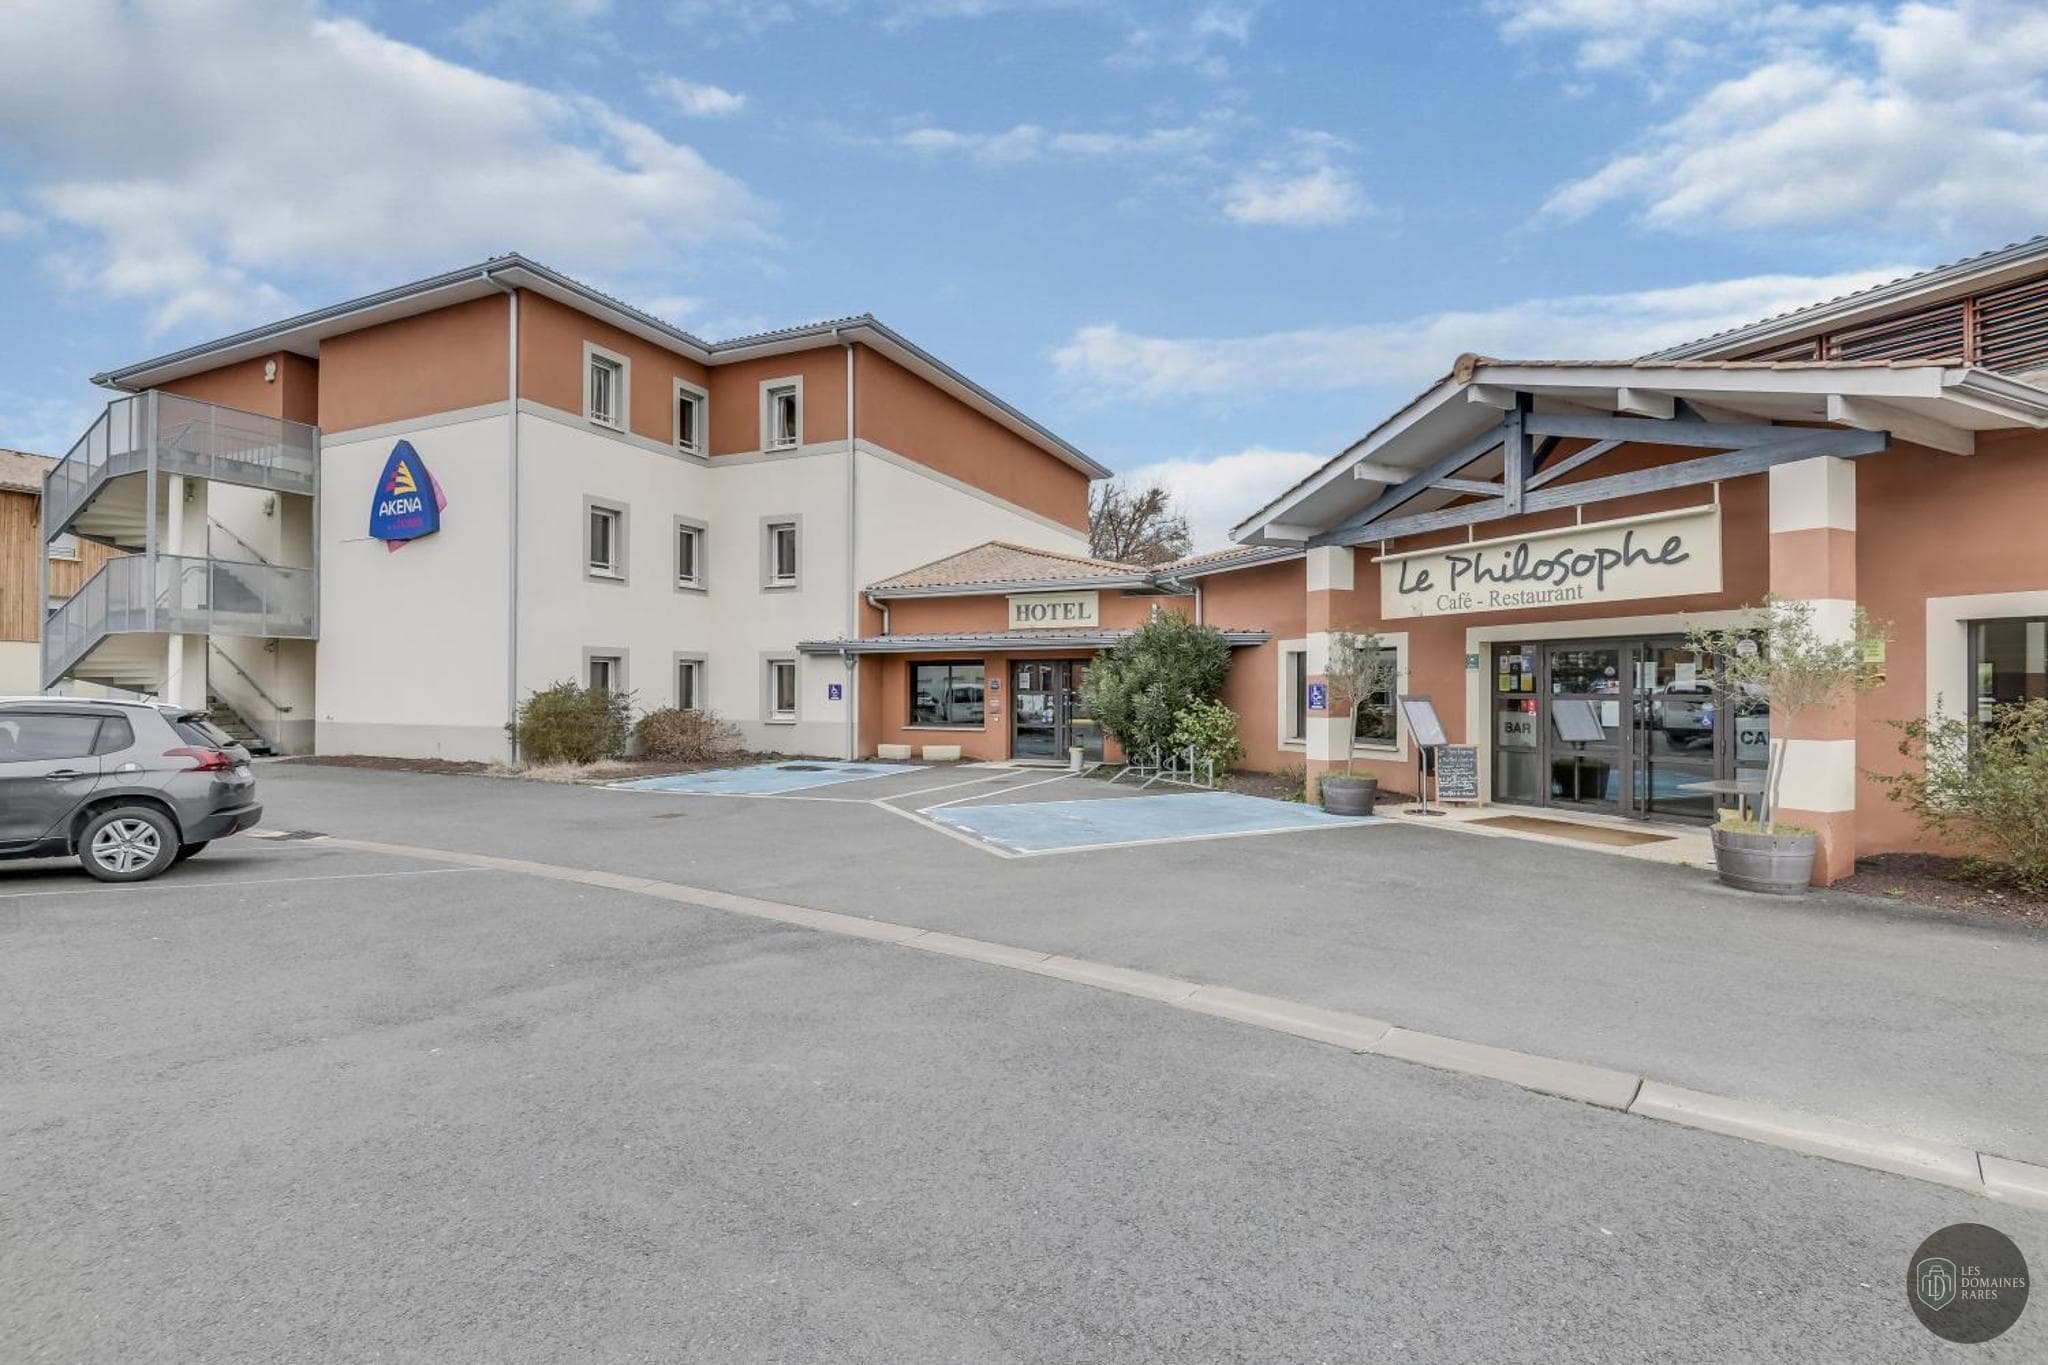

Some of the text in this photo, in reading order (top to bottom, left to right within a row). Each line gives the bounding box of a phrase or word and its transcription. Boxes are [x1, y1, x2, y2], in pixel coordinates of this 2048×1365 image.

[379, 496, 423, 517] AKENA
[1398, 529, 1690, 595] Le Philosophe
[1437, 592, 1473, 611] Café
[1489, 583, 1584, 608] Restaurant
[1015, 602, 1092, 622] HOTEL
[1504, 721, 1532, 734] BAR
